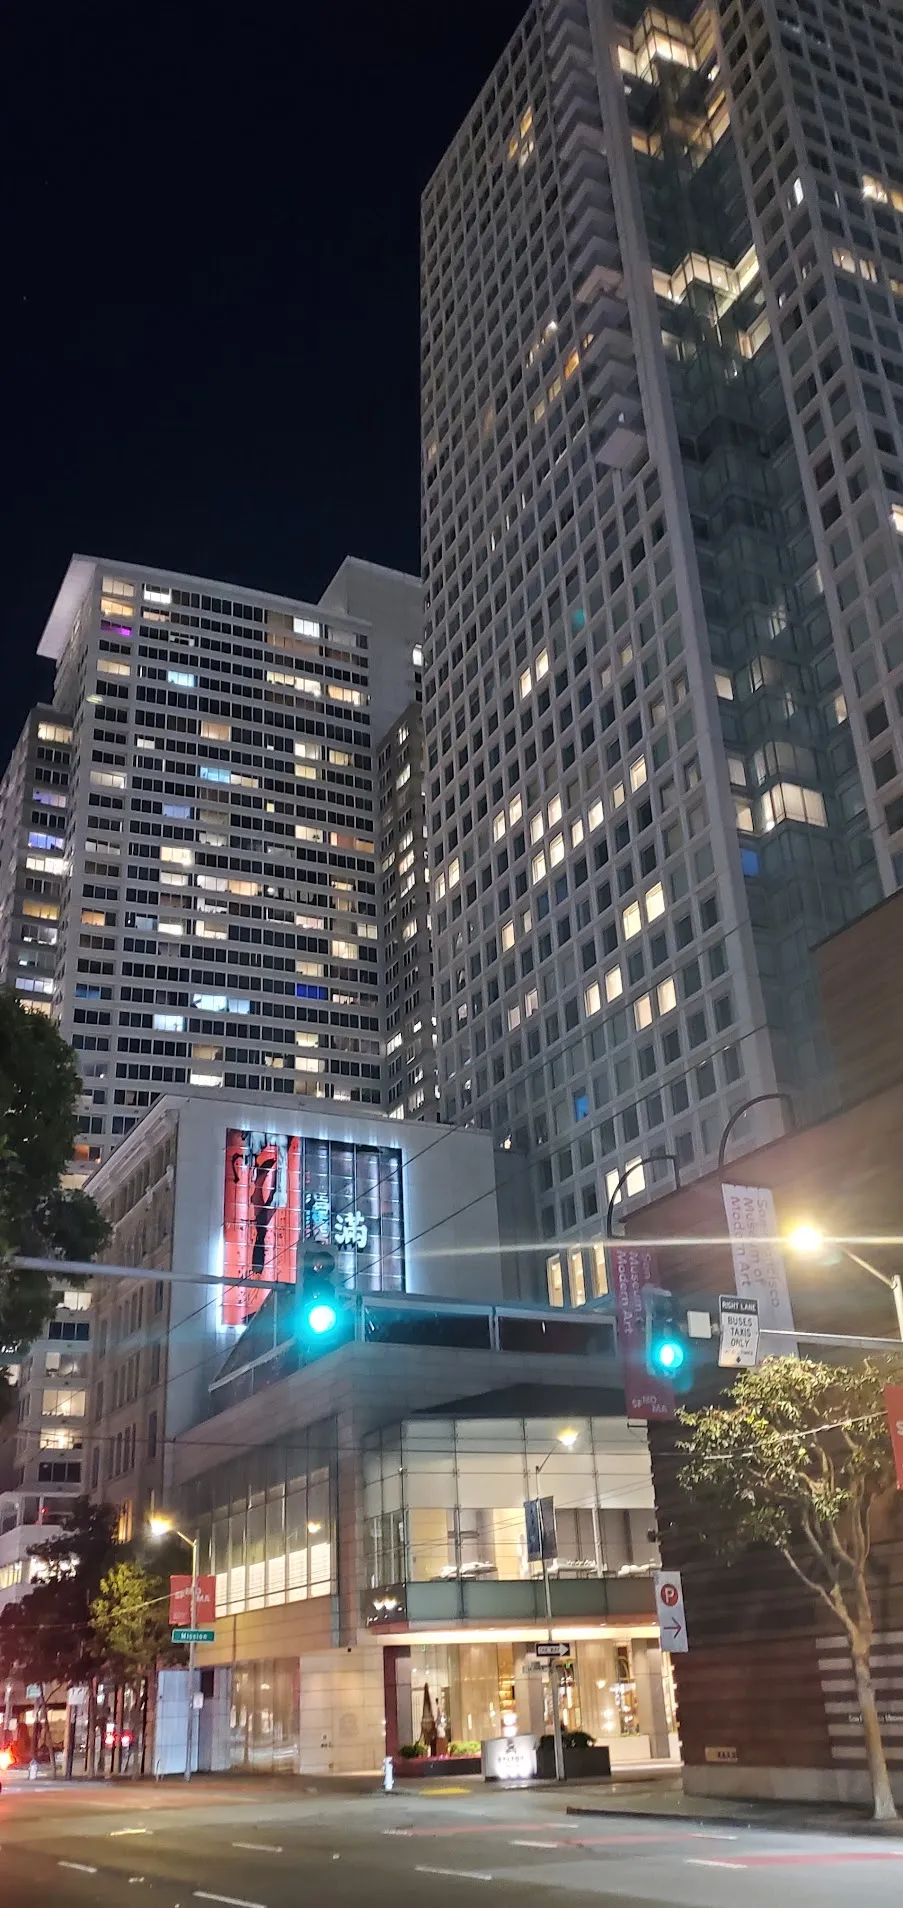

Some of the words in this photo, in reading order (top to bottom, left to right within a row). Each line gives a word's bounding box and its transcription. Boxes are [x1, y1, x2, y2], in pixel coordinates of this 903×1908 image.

[730, 1195, 746, 1256] Moden
[738, 1262, 752, 1287] Art
[628, 1251, 642, 1312] Museum
[616, 1249, 629, 1306] Modern
[623, 1310, 634, 1335] Art
[722, 1300, 739, 1310] RIGHT
[741, 1302, 756, 1311] LANE
[727, 1316, 753, 1327] BUSES
[731, 1327, 751, 1337] TAXIS
[731, 1337, 750, 1348] ONLY
[664, 1587, 675, 1604] P
[180, 1632, 208, 1640] Mission
